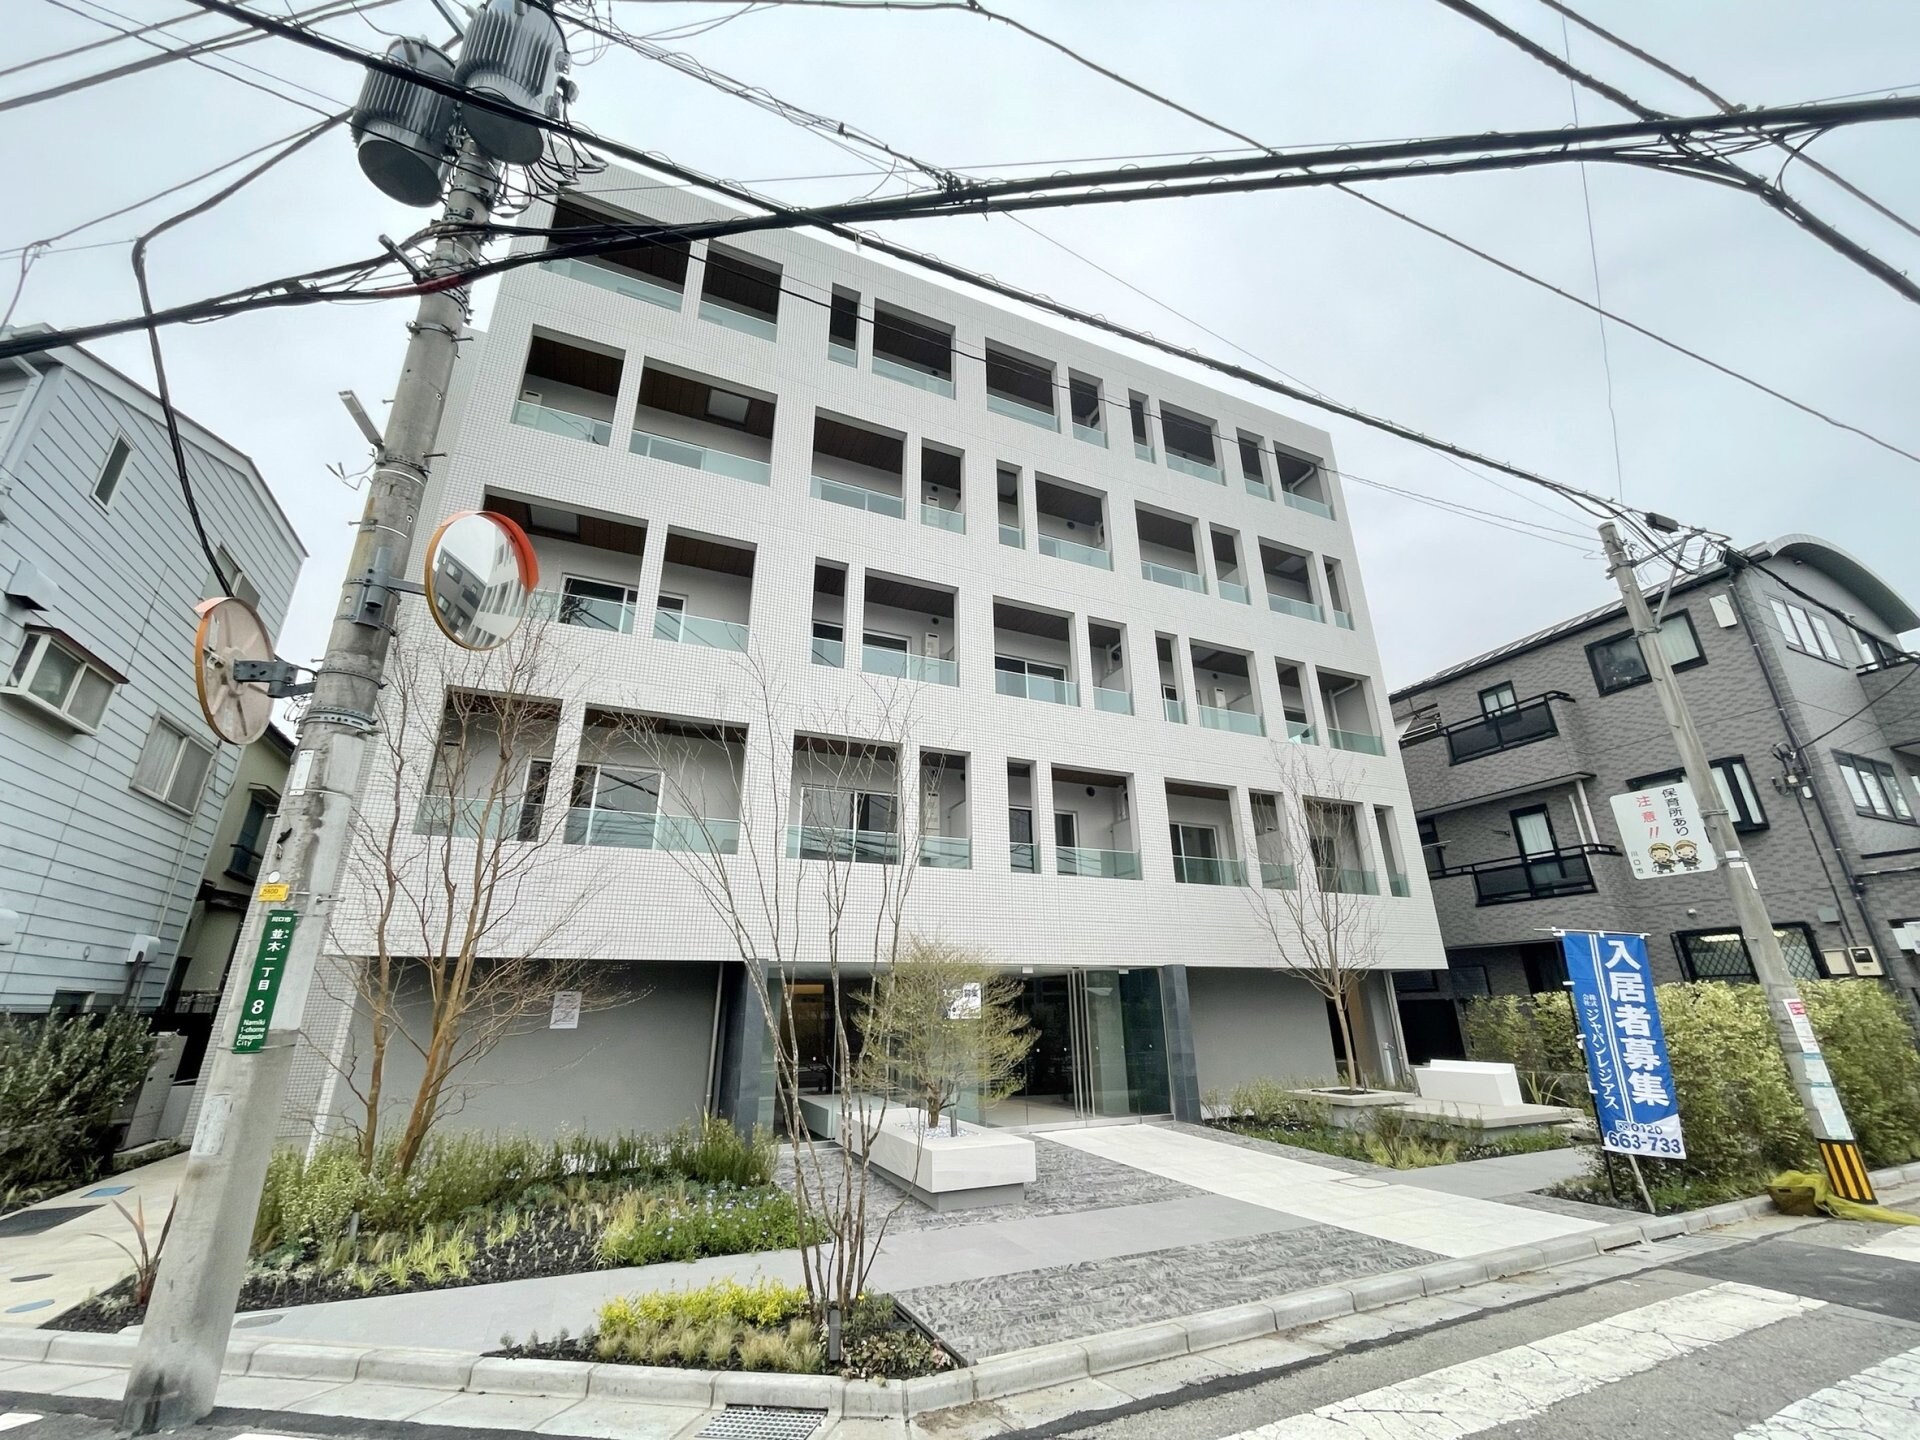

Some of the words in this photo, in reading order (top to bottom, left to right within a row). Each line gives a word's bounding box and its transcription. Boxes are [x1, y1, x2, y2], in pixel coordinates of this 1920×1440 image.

[1662, 787, 1689, 837] 保育所あり
[257, 928, 285, 991] 並木一丁目
[251, 999, 265, 1015] 8
[1604, 940, 1670, 1107] 入居者募集
[236, 1039, 252, 1047] City
[1631, 1123, 1663, 1135] 0120
[1608, 1131, 1681, 1154] 663-733
